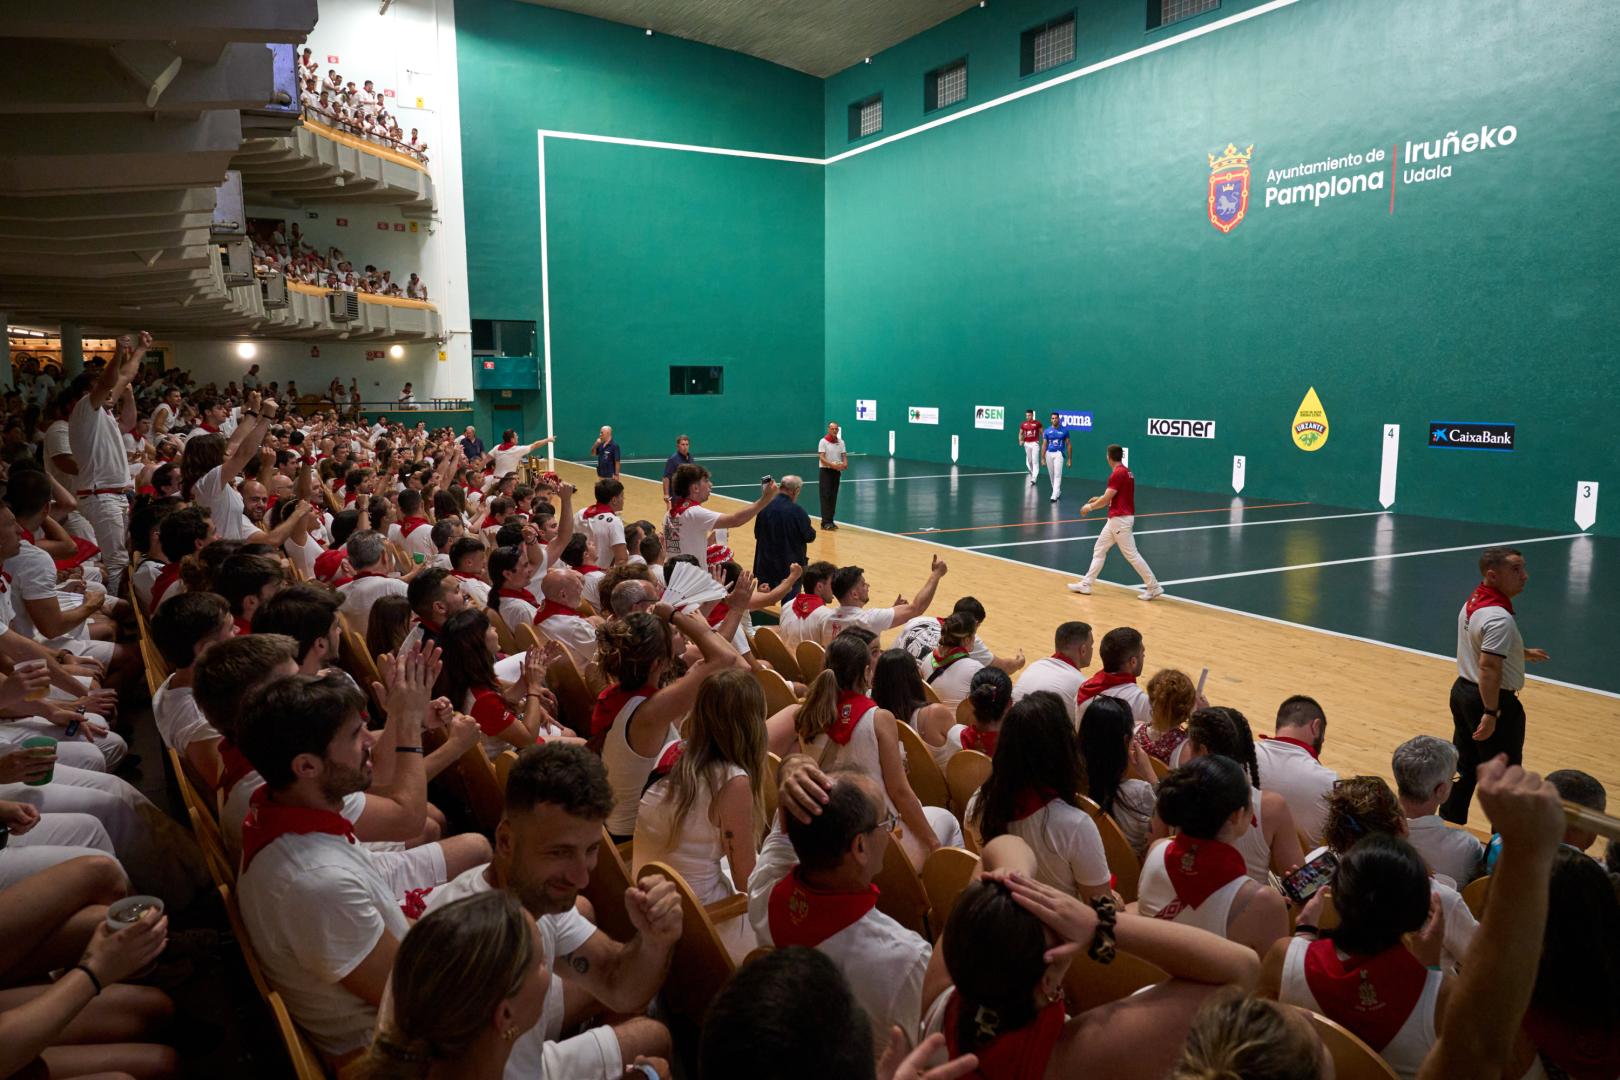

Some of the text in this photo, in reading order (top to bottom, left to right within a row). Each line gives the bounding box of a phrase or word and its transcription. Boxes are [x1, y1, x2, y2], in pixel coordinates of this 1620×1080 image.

[1404, 125, 1518, 164] Iruñeko
[1266, 148, 1385, 185] Ayuntamiento de
[1403, 164, 1452, 185] Udala
[1265, 170, 1384, 208] Pamplona
[1296, 423, 1324, 432] URZANTE
[1388, 428, 1394, 438] 4
[1449, 429, 1511, 444] CaixaBank
[1237, 459, 1242, 469] 5
[1583, 486, 1591, 498] 3
